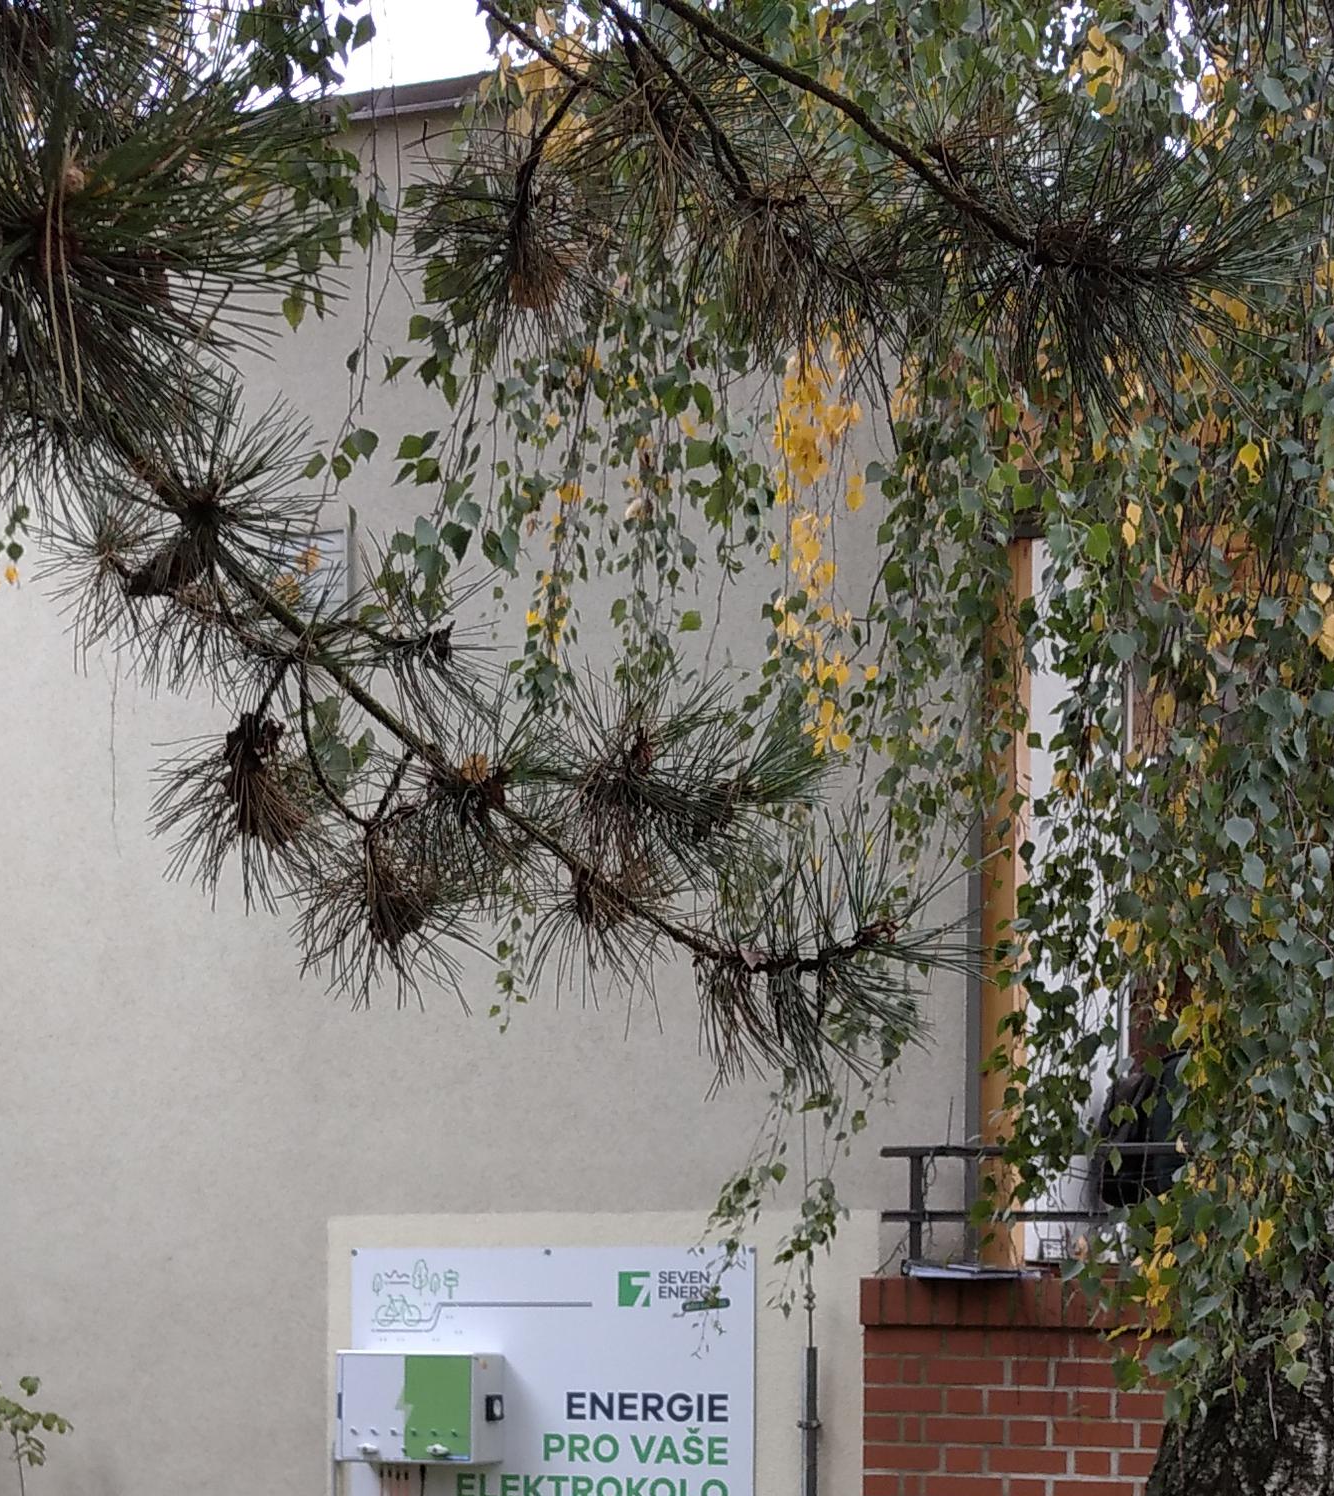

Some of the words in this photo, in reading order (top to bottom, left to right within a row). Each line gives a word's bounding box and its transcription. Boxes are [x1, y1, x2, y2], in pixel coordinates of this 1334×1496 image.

[658, 1285, 717, 1299] ENERG
[566, 1392, 729, 1423] ENERGIE
[543, 1433, 619, 1463] PRO
[630, 1427, 729, 1466] VAŠE
